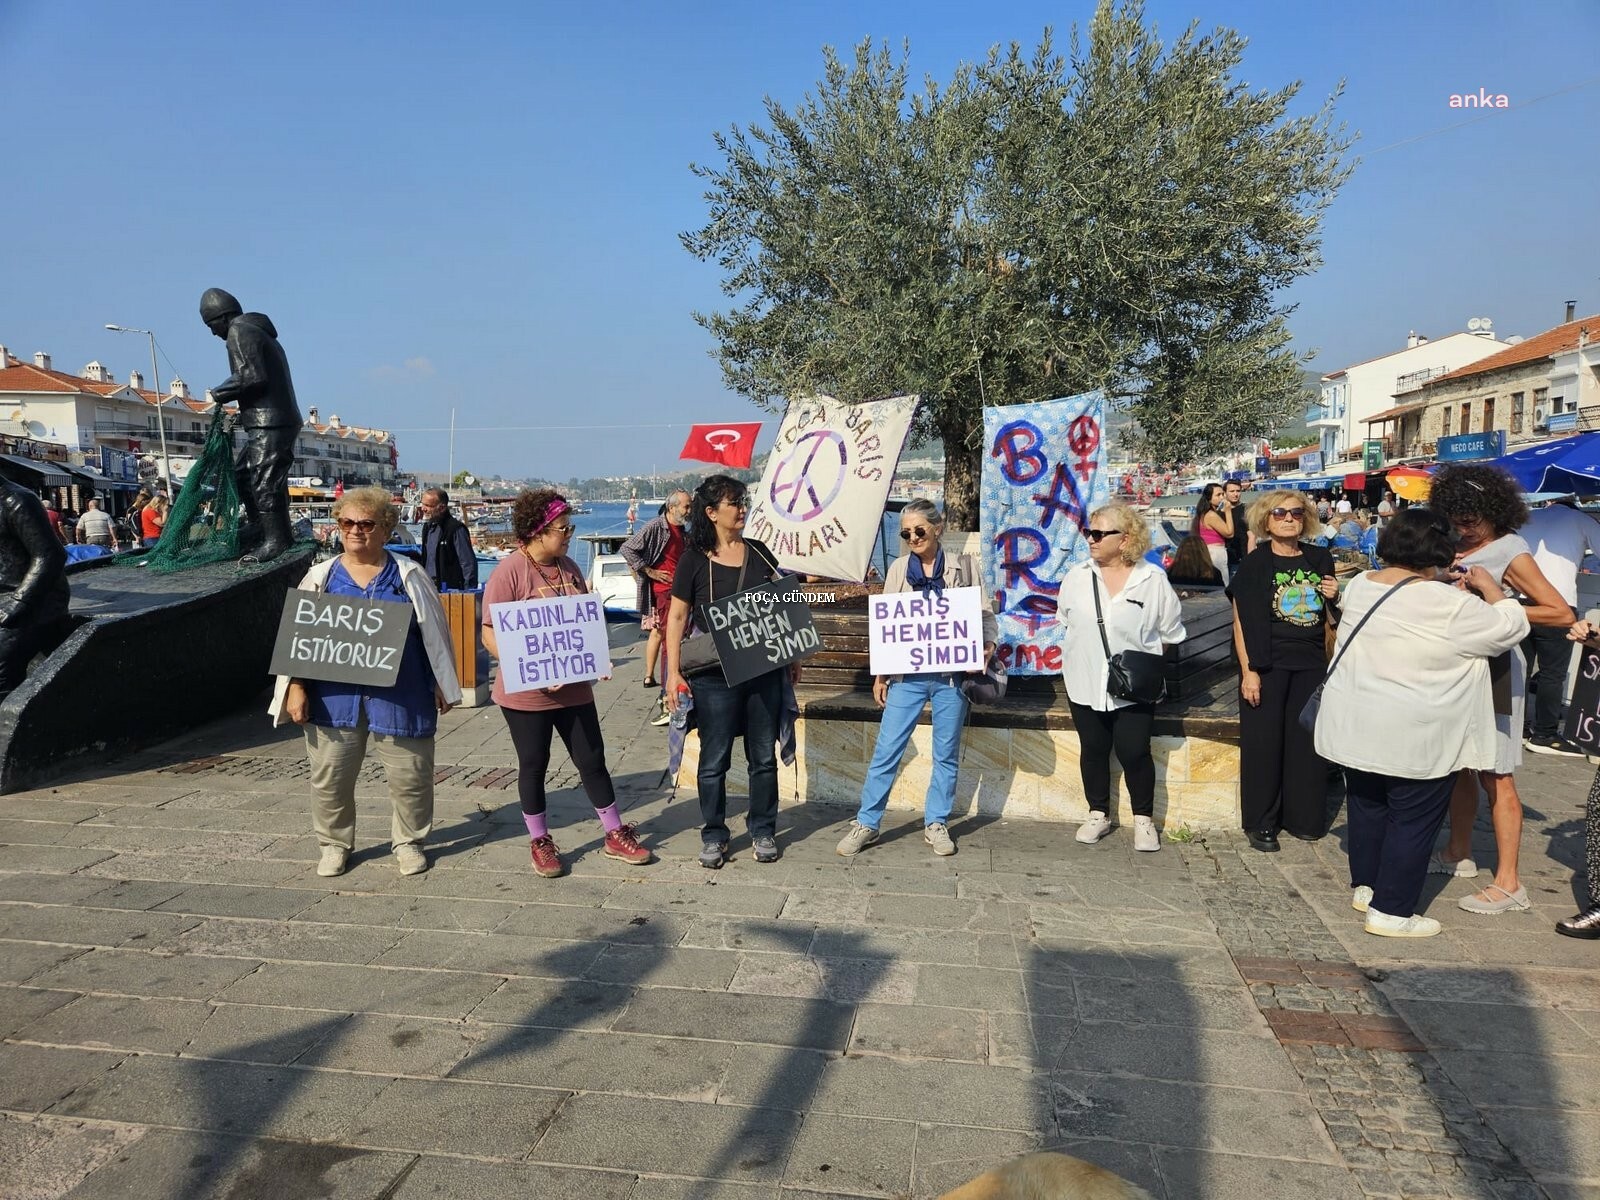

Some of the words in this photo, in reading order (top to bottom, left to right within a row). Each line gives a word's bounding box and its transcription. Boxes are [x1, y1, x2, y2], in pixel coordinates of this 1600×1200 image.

[845, 407, 884, 482] BARIŞ
[1467, 441, 1485, 451] CAFE
[751, 501, 848, 557] KADINLARI
[294, 598, 384, 636] BARIŞ
[498, 601, 599, 632] KADINLAR
[875, 597, 950, 620] BARIŞ
[525, 629, 584, 655] BARIŞ
[728, 610, 793, 650] HEMEN
[882, 620, 968, 643] HEMEN
[290, 632, 397, 670] İSTİYORUZ
[910, 640, 977, 671] ŞİMDİ
[996, 643, 1063, 671] eme
[518, 653, 596, 684] İSTİYOR
